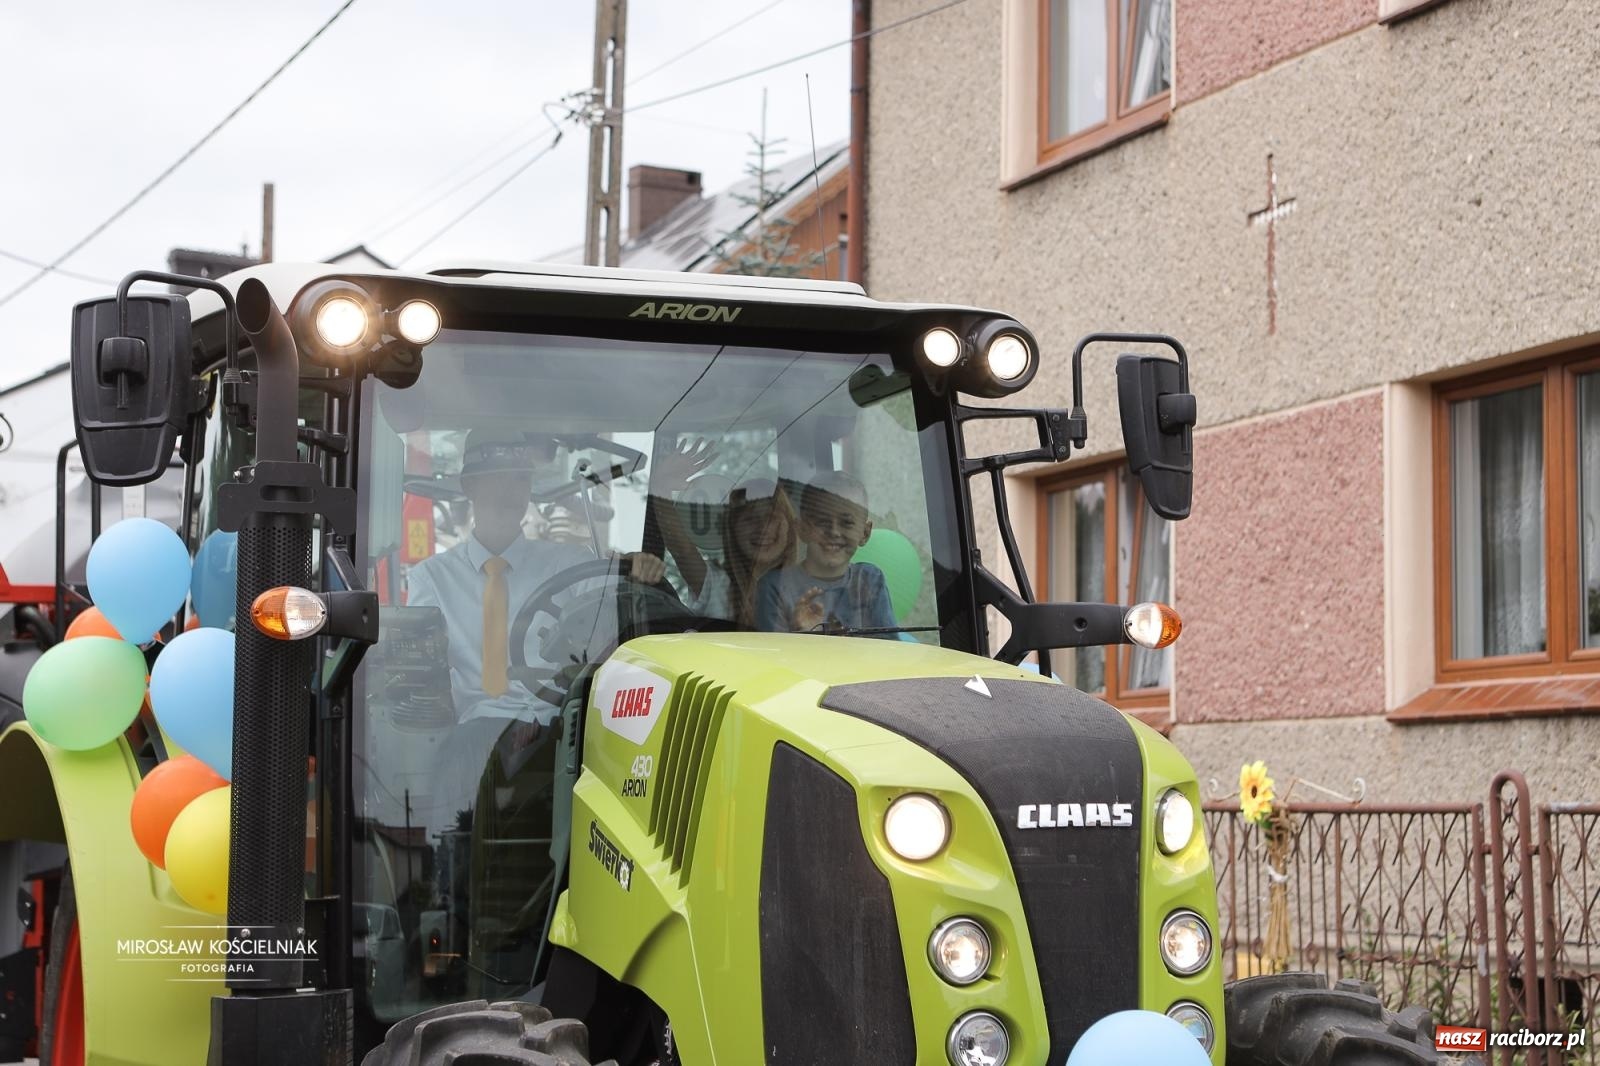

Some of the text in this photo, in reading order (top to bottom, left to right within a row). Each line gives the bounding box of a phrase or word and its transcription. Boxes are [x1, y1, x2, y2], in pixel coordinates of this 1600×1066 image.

[628, 302, 743, 322] ARION
[611, 686, 654, 718] CLAAS
[630, 755, 653, 778] 430
[621, 778, 647, 798] ARION
[1017, 803, 1133, 829] CLAAS
